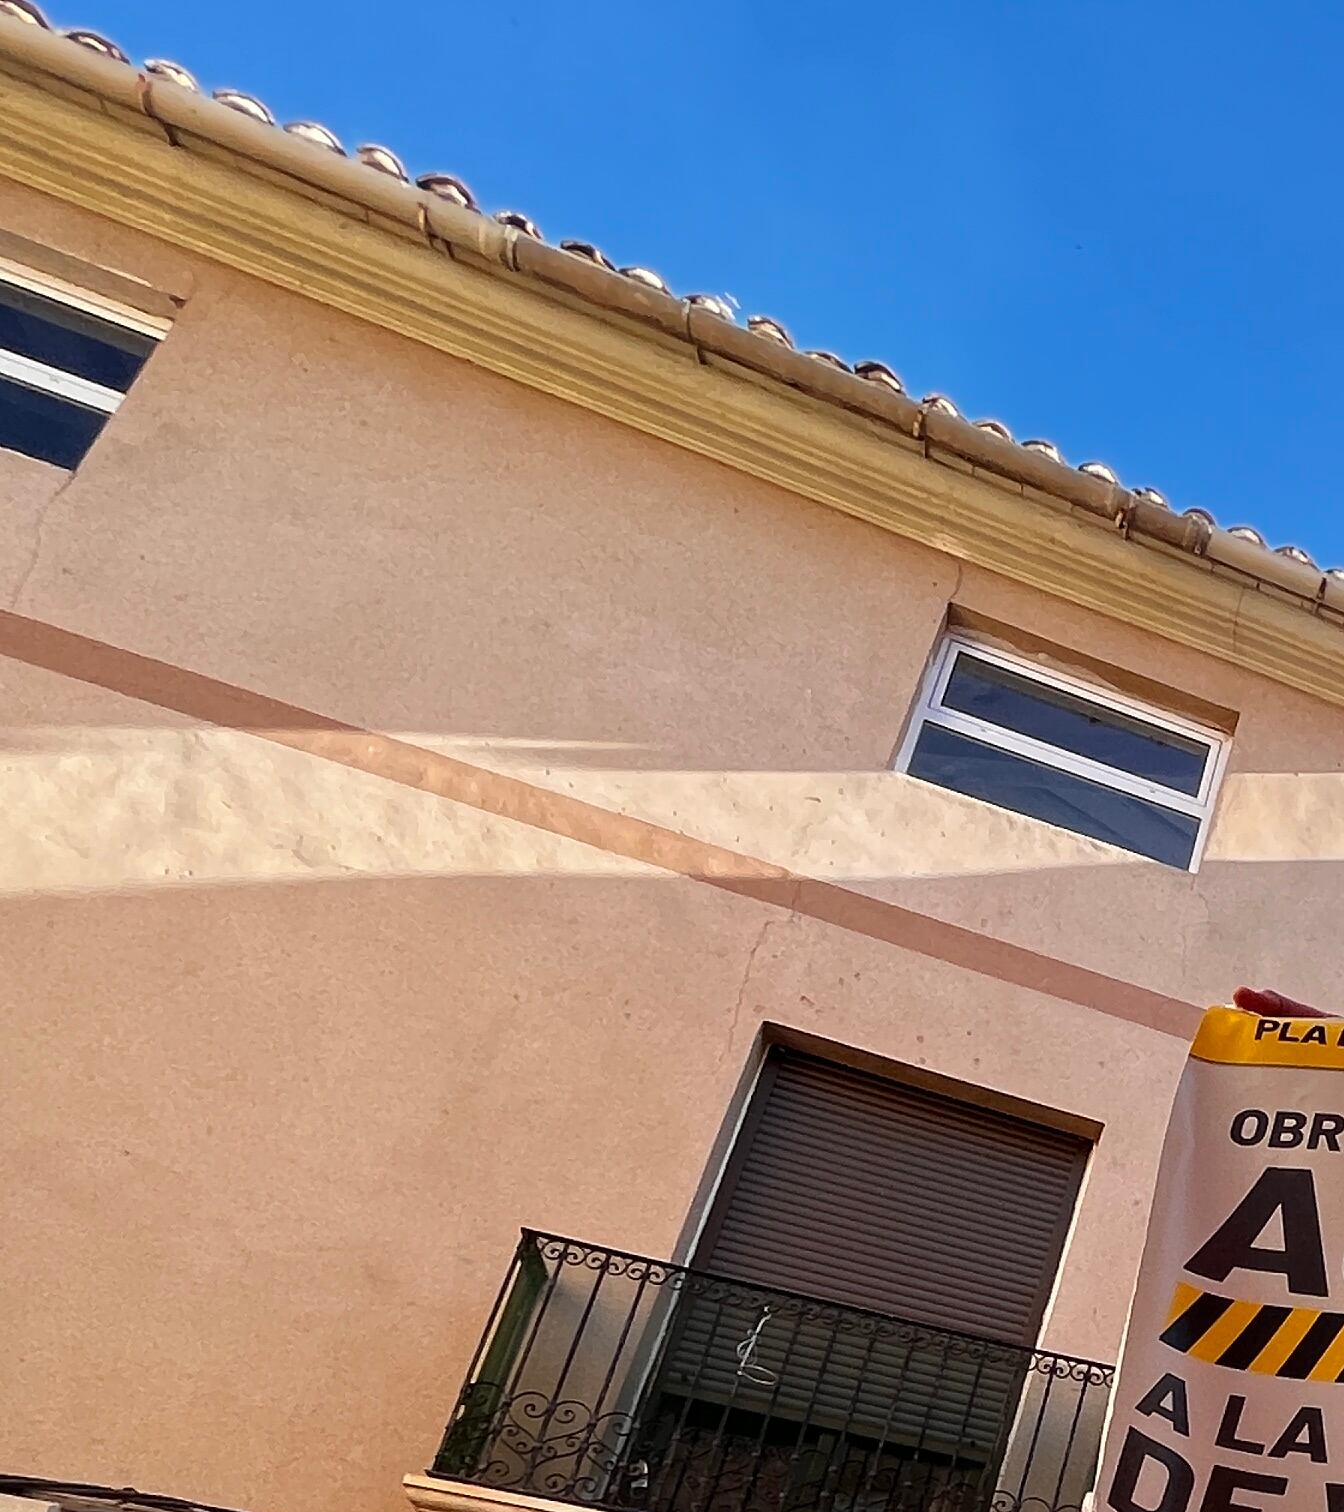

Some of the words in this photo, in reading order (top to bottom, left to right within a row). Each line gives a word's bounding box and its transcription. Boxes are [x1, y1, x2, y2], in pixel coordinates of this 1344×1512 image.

[1254, 1019, 1327, 1045] PLA
[1135, 1372, 1191, 1437] A
[1214, 1394, 1328, 1463] LA
